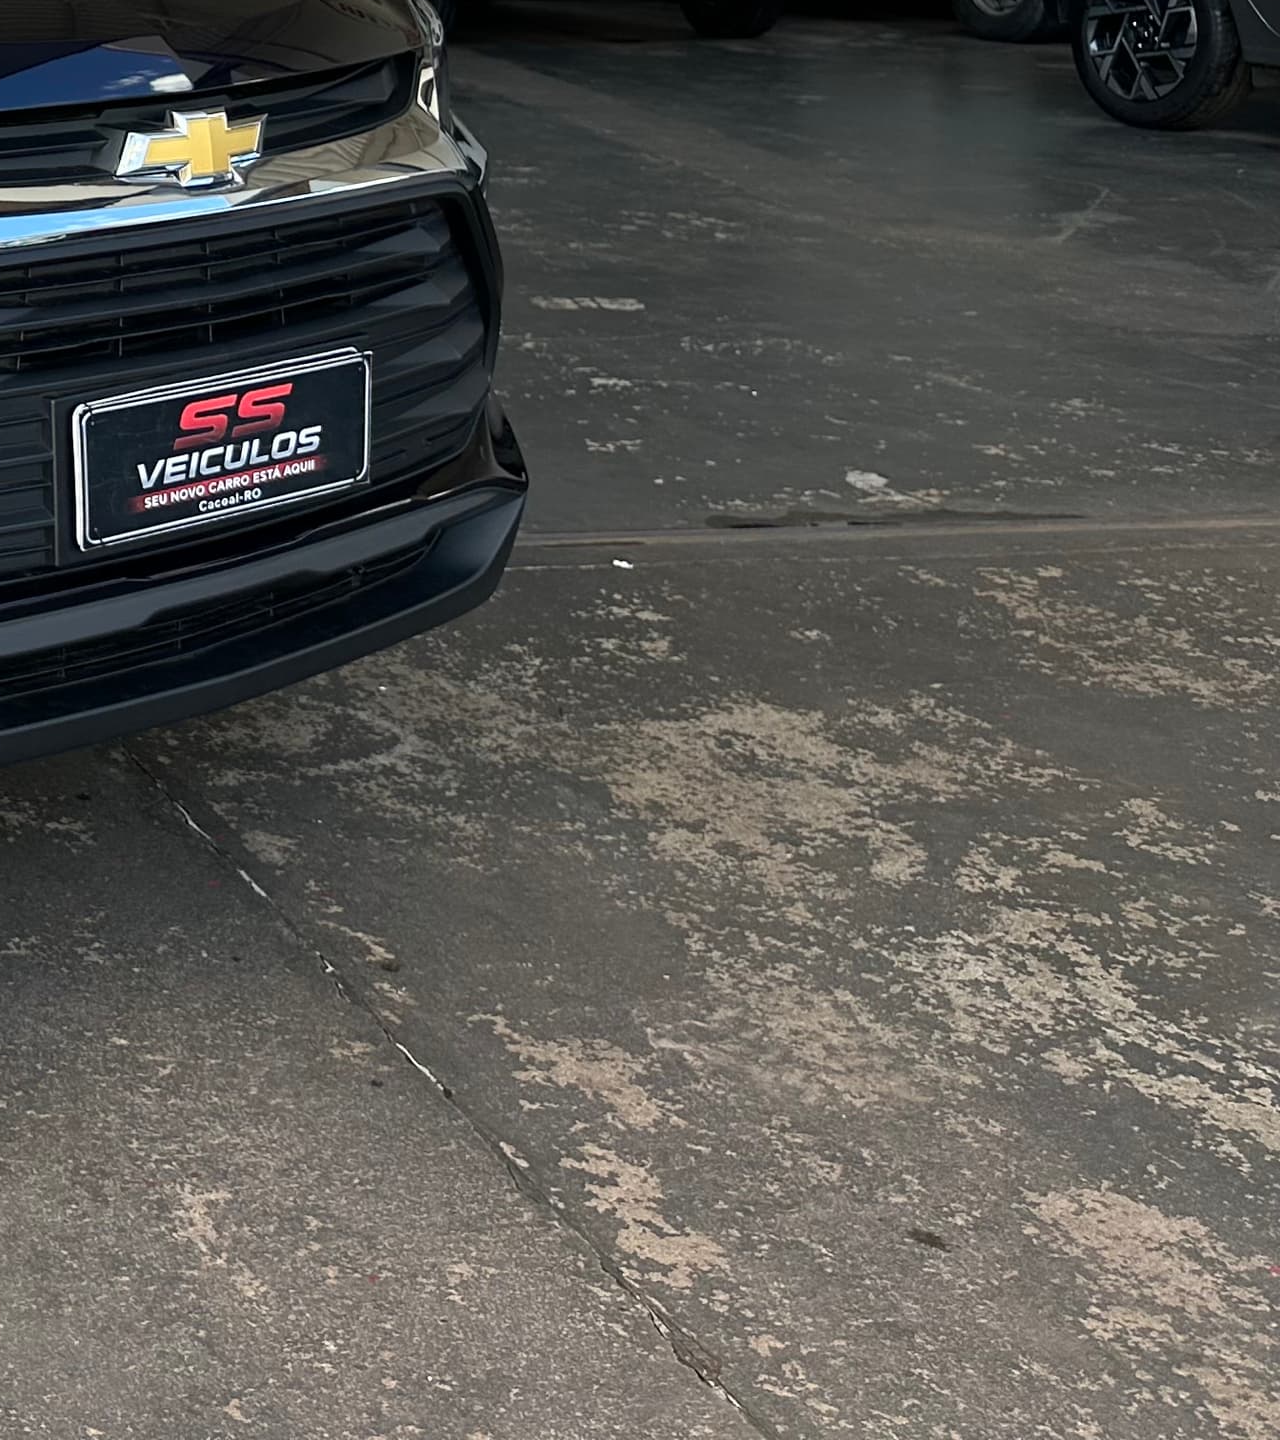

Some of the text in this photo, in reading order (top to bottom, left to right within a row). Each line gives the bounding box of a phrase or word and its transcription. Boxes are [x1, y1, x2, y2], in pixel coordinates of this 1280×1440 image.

[173, 383, 293, 451] SS
[137, 425, 322, 489] VEICULOS
[144, 494, 167, 509] SEU
[170, 485, 205, 503] NOVO
[208, 474, 250, 494] CARRO
[253, 465, 282, 484] ESTÁ
[199, 488, 262, 512] Cacoal-RO
